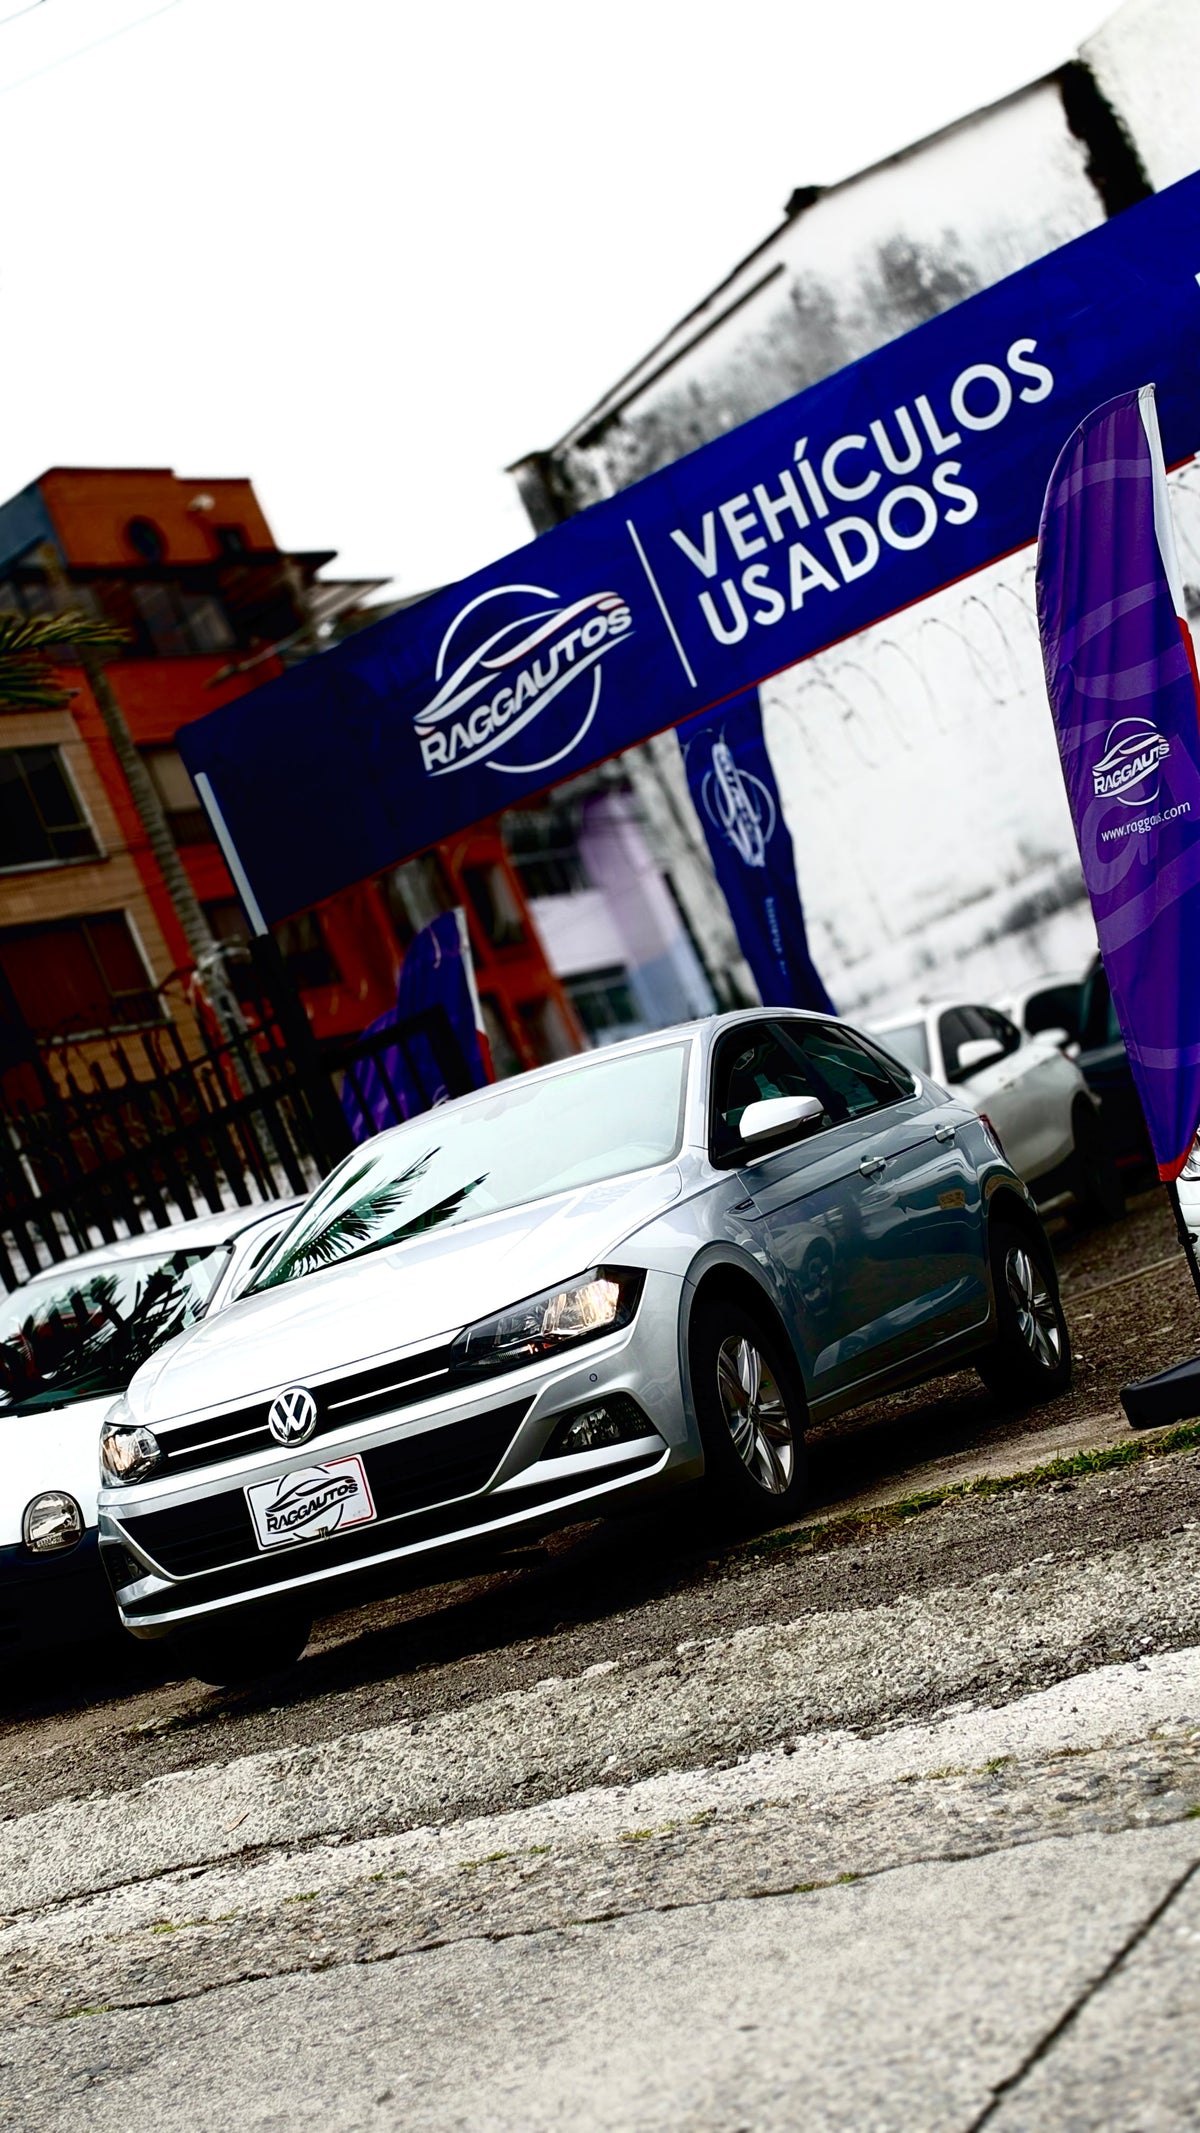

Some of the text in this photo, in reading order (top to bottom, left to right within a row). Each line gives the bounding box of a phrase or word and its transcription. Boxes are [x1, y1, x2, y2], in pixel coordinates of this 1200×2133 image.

[669, 337, 1055, 580] VEHÍCULOS
[697, 460, 979, 646] USADOS
[419, 605, 633, 772] RAGGAUTOS
[266, 1482, 359, 1532] RAGGAUTOS
